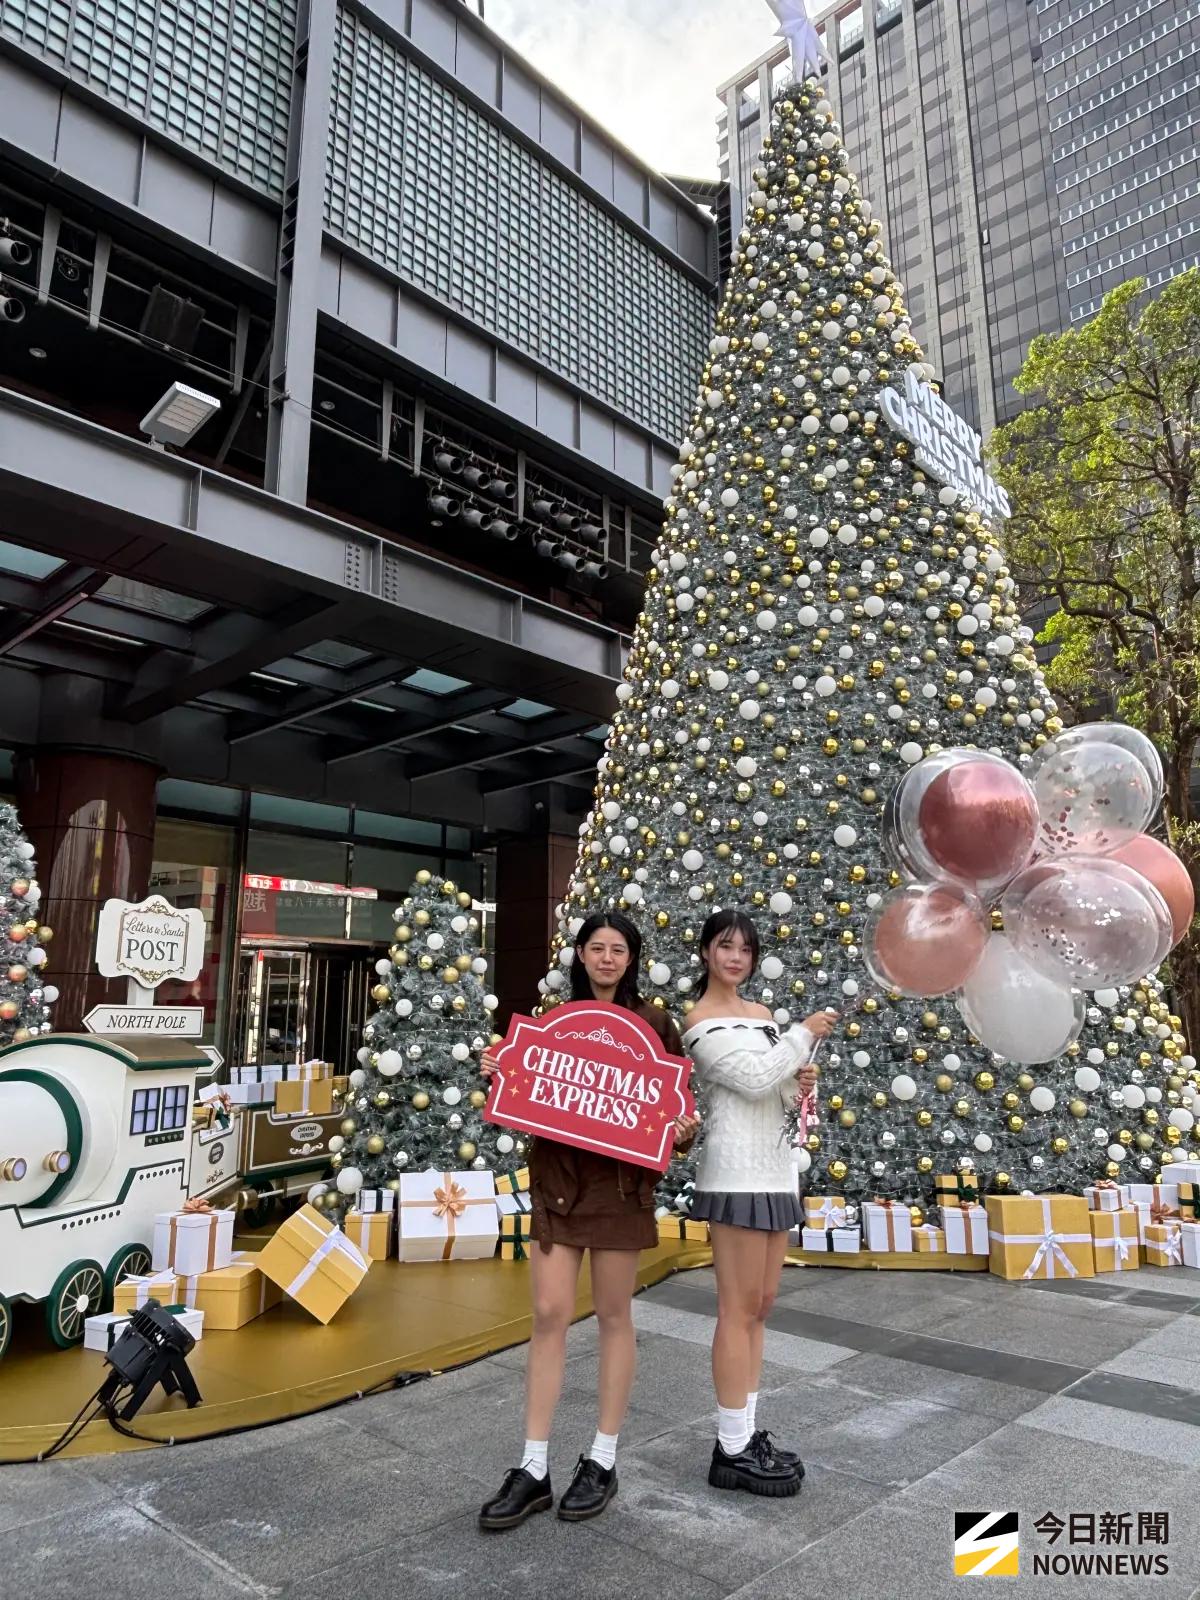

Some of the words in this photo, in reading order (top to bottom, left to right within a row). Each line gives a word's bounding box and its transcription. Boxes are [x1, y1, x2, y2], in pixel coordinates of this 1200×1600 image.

[906, 370, 981, 462] MERRY
[882, 387, 1011, 518] CHRISTMAS
[125, 938, 179, 962] POST
[126, 917, 153, 934] Letters
[161, 923, 184, 936] Santa
[107, 1015, 155, 1029] NORTH
[155, 1016, 186, 1029] POLE
[523, 1045, 663, 1105] CHRISTMAS
[528, 1076, 641, 1130] EXPRESS
